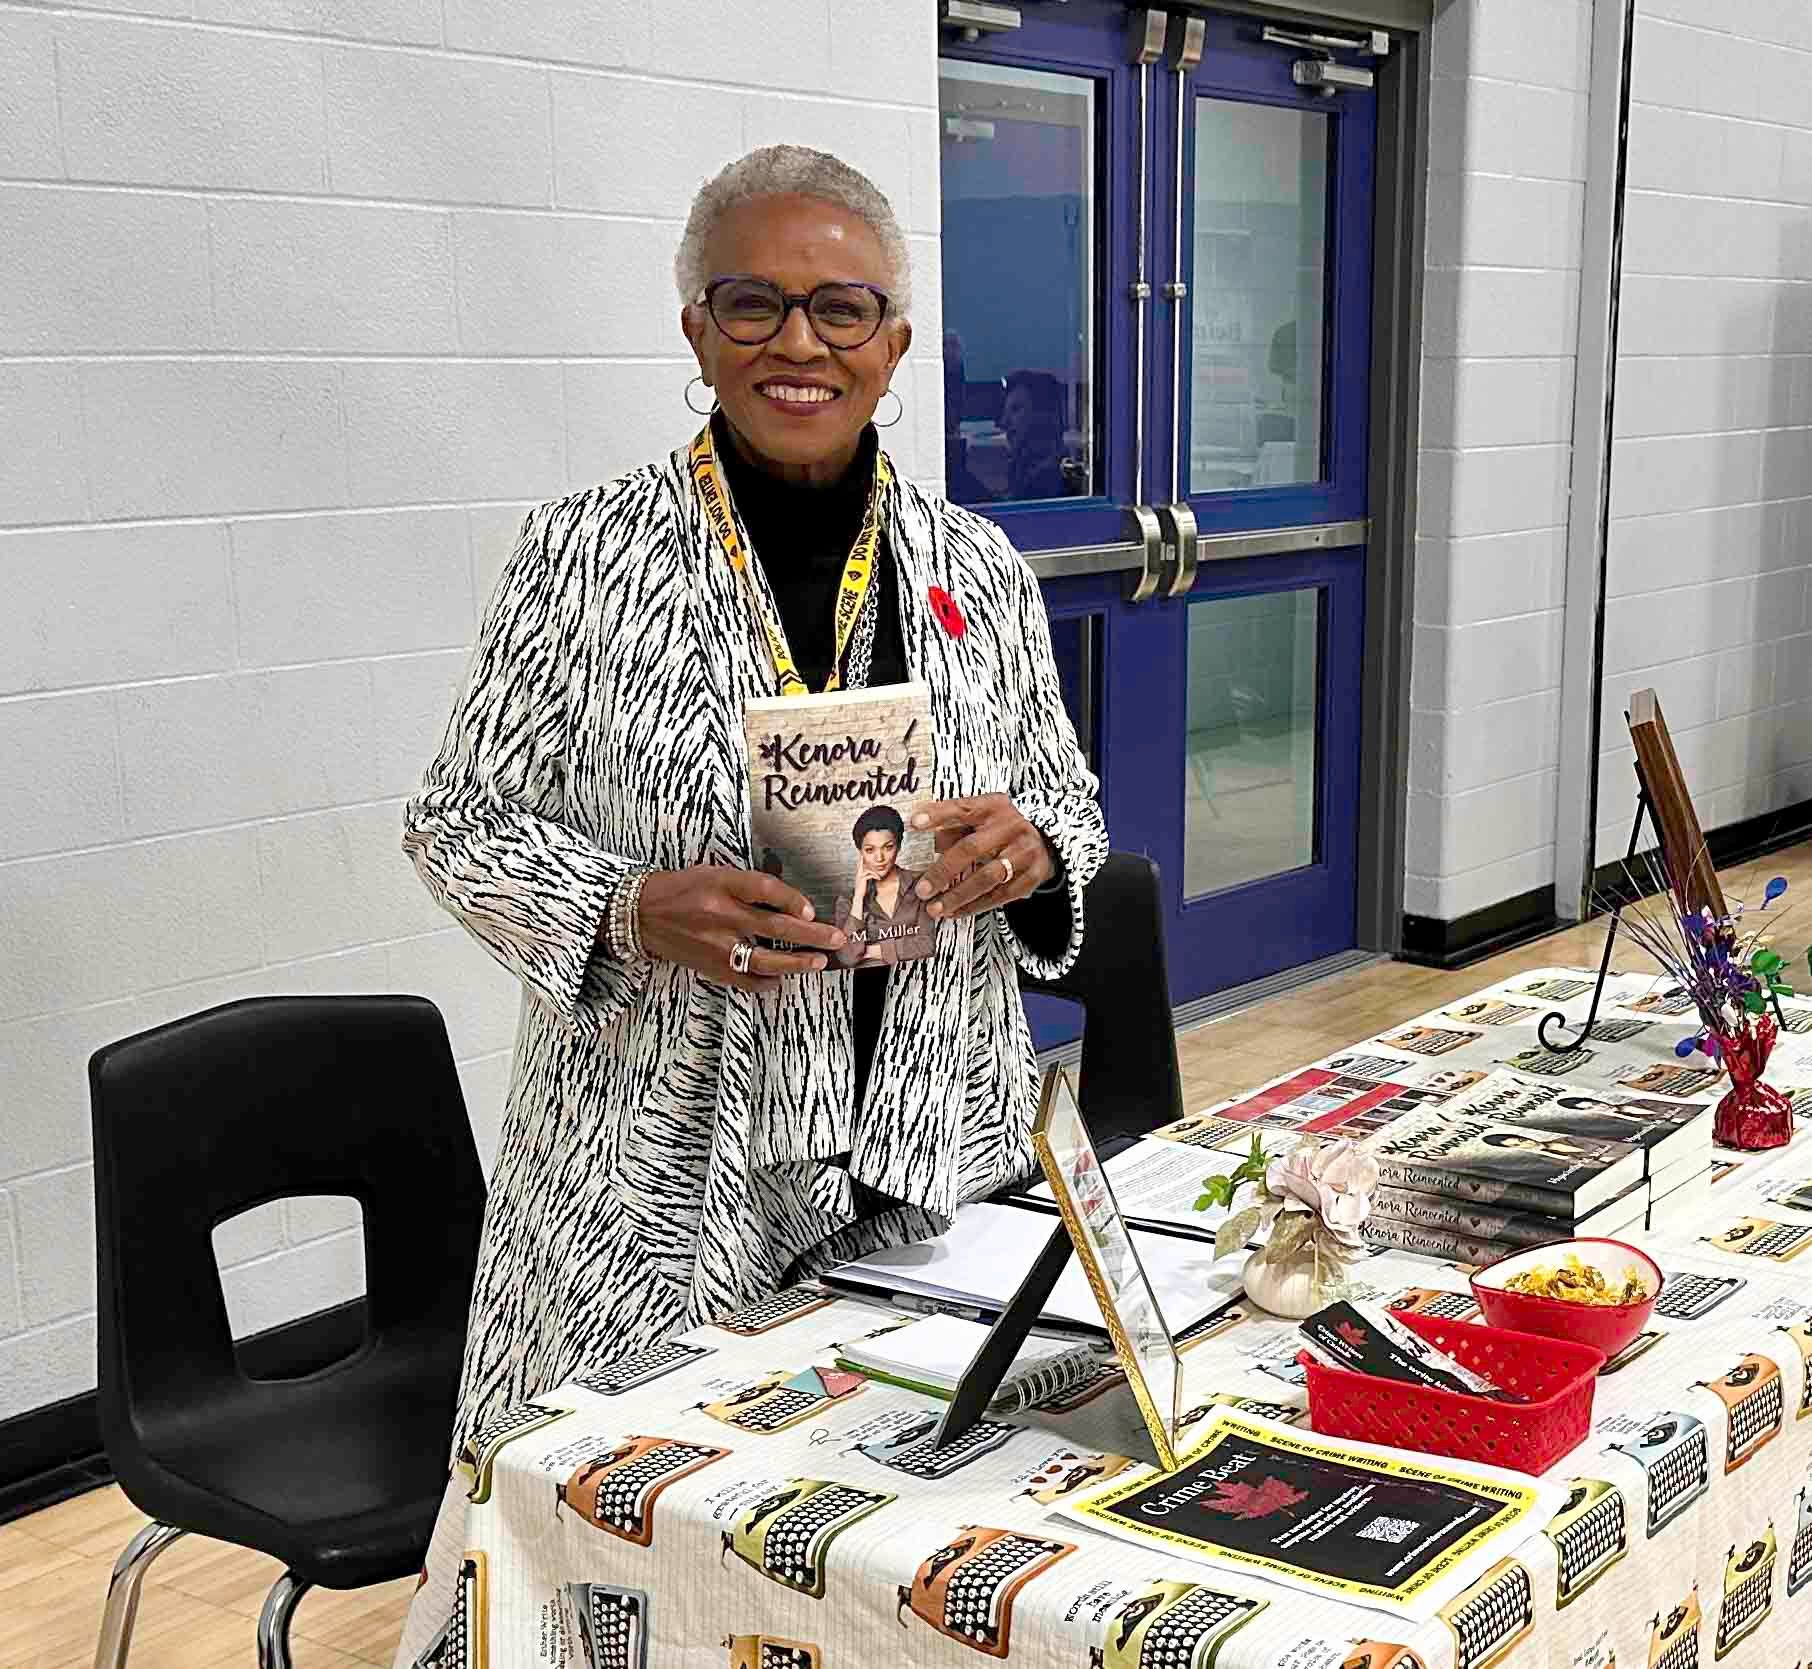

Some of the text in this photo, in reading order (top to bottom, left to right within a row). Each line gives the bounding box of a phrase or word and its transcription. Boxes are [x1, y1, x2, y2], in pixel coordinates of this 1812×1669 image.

[851, 547, 869, 561] DO
[839, 587, 859, 620] SCENE
[770, 732, 882, 772] Kenora
[761, 757, 920, 811] Reinvented
[878, 924, 921, 940] Miller
[1378, 1167, 1461, 1189] ora Reinvented
[1376, 1200, 1462, 1225] nora Reinvented
[1360, 1221, 1459, 1254] Kenora Reinvented
[1389, 1352, 1408, 1367] The
[1221, 1419, 1261, 1437] WRITING
[1269, 1436, 1301, 1450] SCENE
[1301, 1445, 1315, 1453] OF
[1315, 1449, 1346, 1460] CRIME
[1347, 1455, 1389, 1469] WRITING
[1398, 1466, 1433, 1479] SCENE
[1480, 1484, 1523, 1500] WRITING
[1140, 1450, 1258, 1515] Crime Beat
